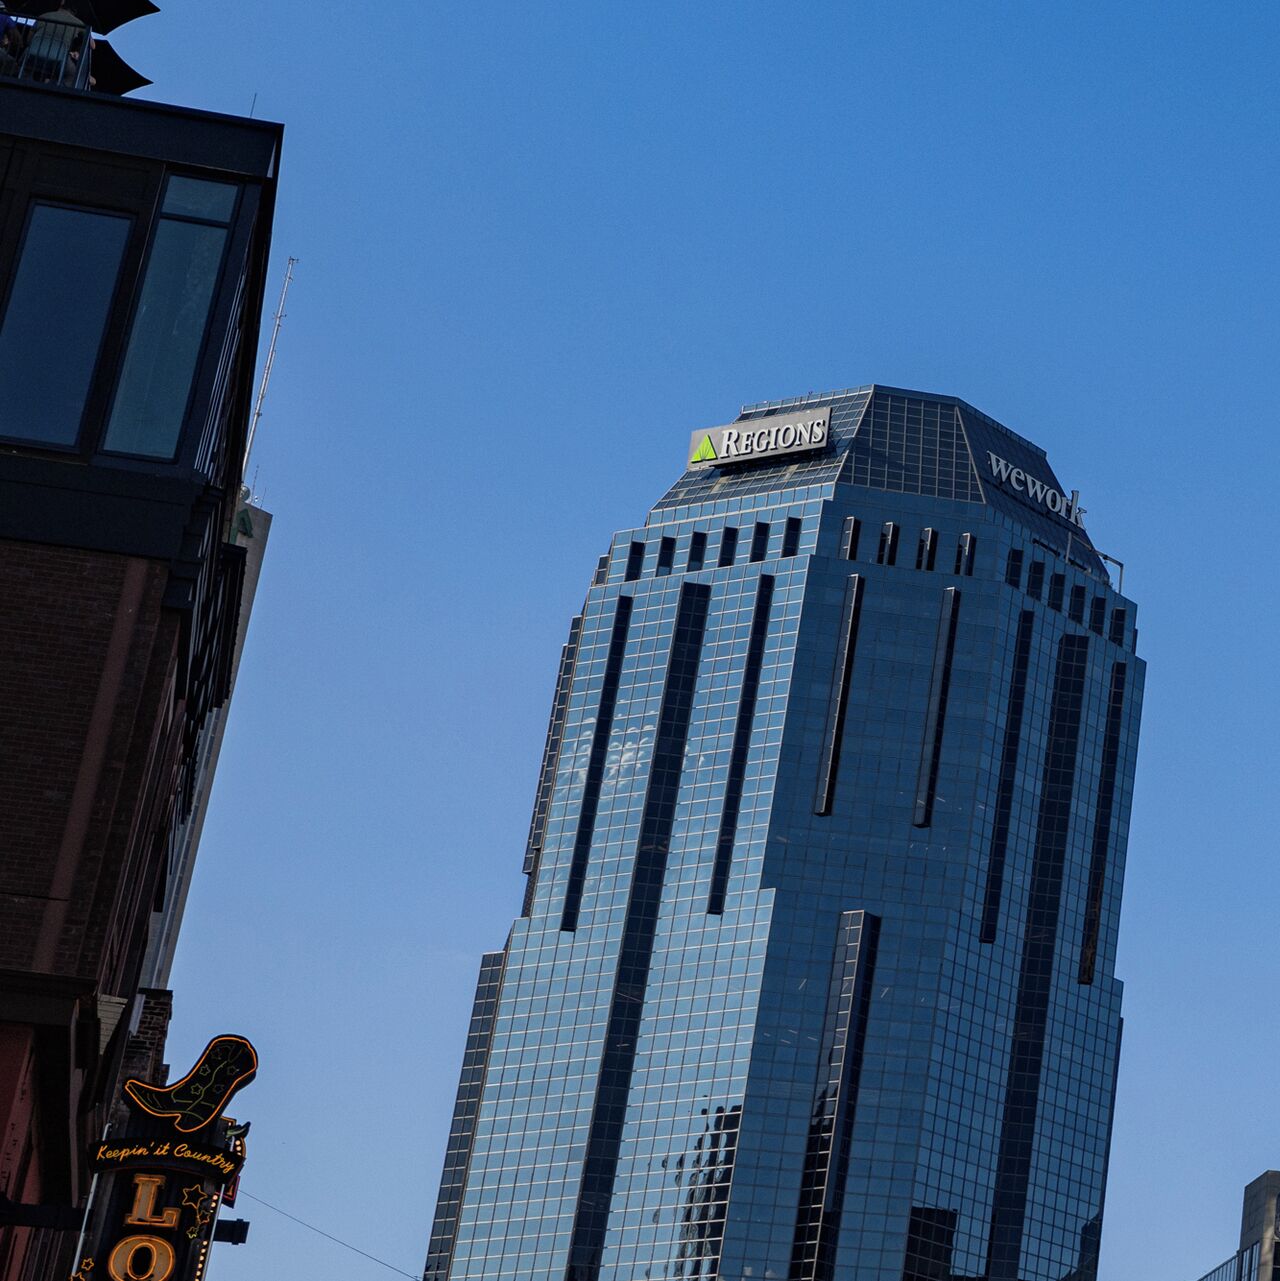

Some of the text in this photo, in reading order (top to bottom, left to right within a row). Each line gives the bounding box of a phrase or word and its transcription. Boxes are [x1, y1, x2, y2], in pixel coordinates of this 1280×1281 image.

[719, 418, 826, 458] REGIONS
[987, 450, 1086, 525] wework
[96, 1141, 236, 1174] Keepin' it Country
